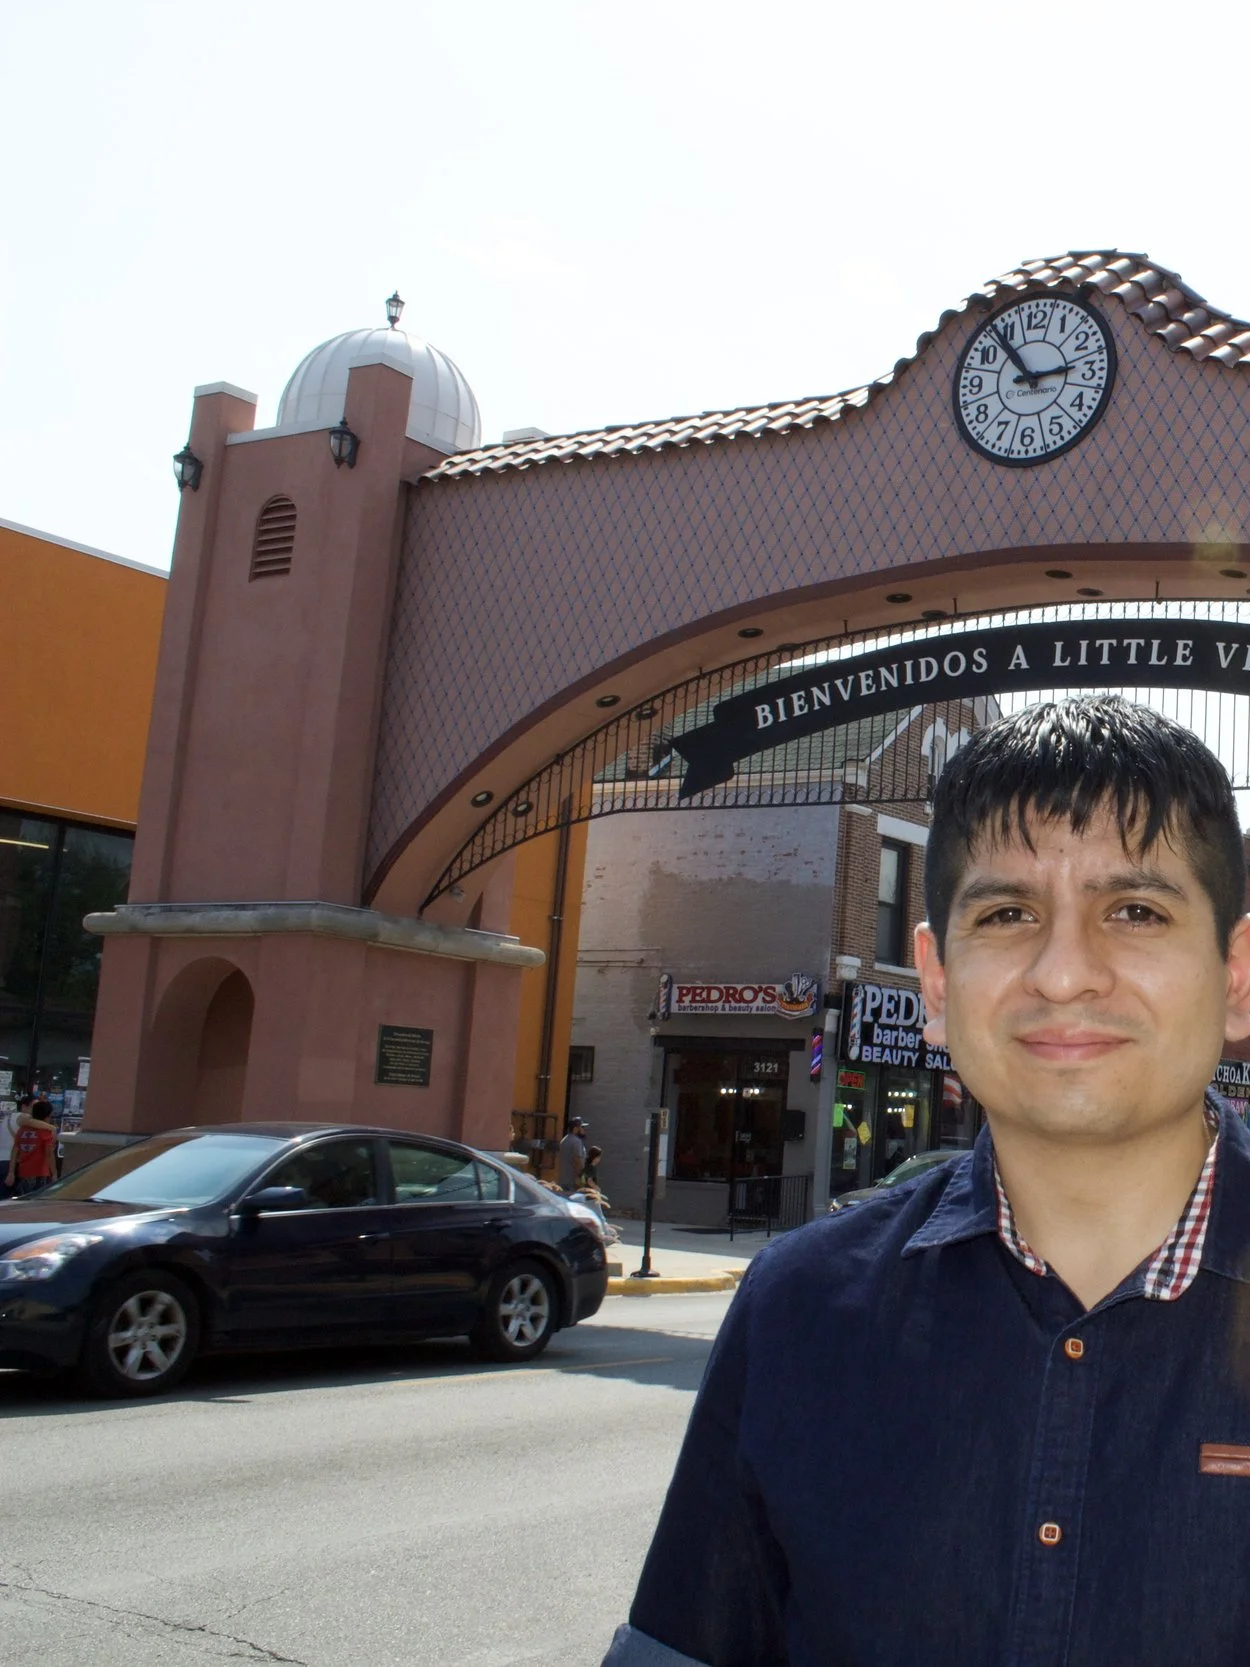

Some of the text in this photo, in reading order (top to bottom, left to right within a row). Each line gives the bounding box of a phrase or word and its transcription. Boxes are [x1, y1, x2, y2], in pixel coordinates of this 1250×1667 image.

[1026, 309, 1047, 331] 12
[1059, 314, 1067, 334] 1
[1002, 320, 1015, 342] 11
[1075, 331, 1090, 352] 2
[980, 345, 997, 365] 10
[1081, 360, 1096, 381] 3
[969, 375, 983, 395] 9
[1069, 391, 1084, 412] 4
[975, 403, 989, 424] 8
[997, 421, 1011, 441] 7
[1049, 415, 1064, 436] 5
[1020, 427, 1035, 447] 6
[755, 648, 988, 730] BIENVENIDOS
[1008, 645, 1030, 670] A
[1053, 639, 1194, 667] LITTLE
[676, 986, 777, 1004] PEDRO'S
[678, 1004, 719, 1013] barbershop
[721, 1004, 726, 1012] &
[728, 1004, 753, 1013] beauty
[755, 1004, 777, 1012] salon
[873, 1023, 922, 1048] barber
[862, 1046, 919, 1067] BEAUTY
[754, 1062, 778, 1073] 3121
